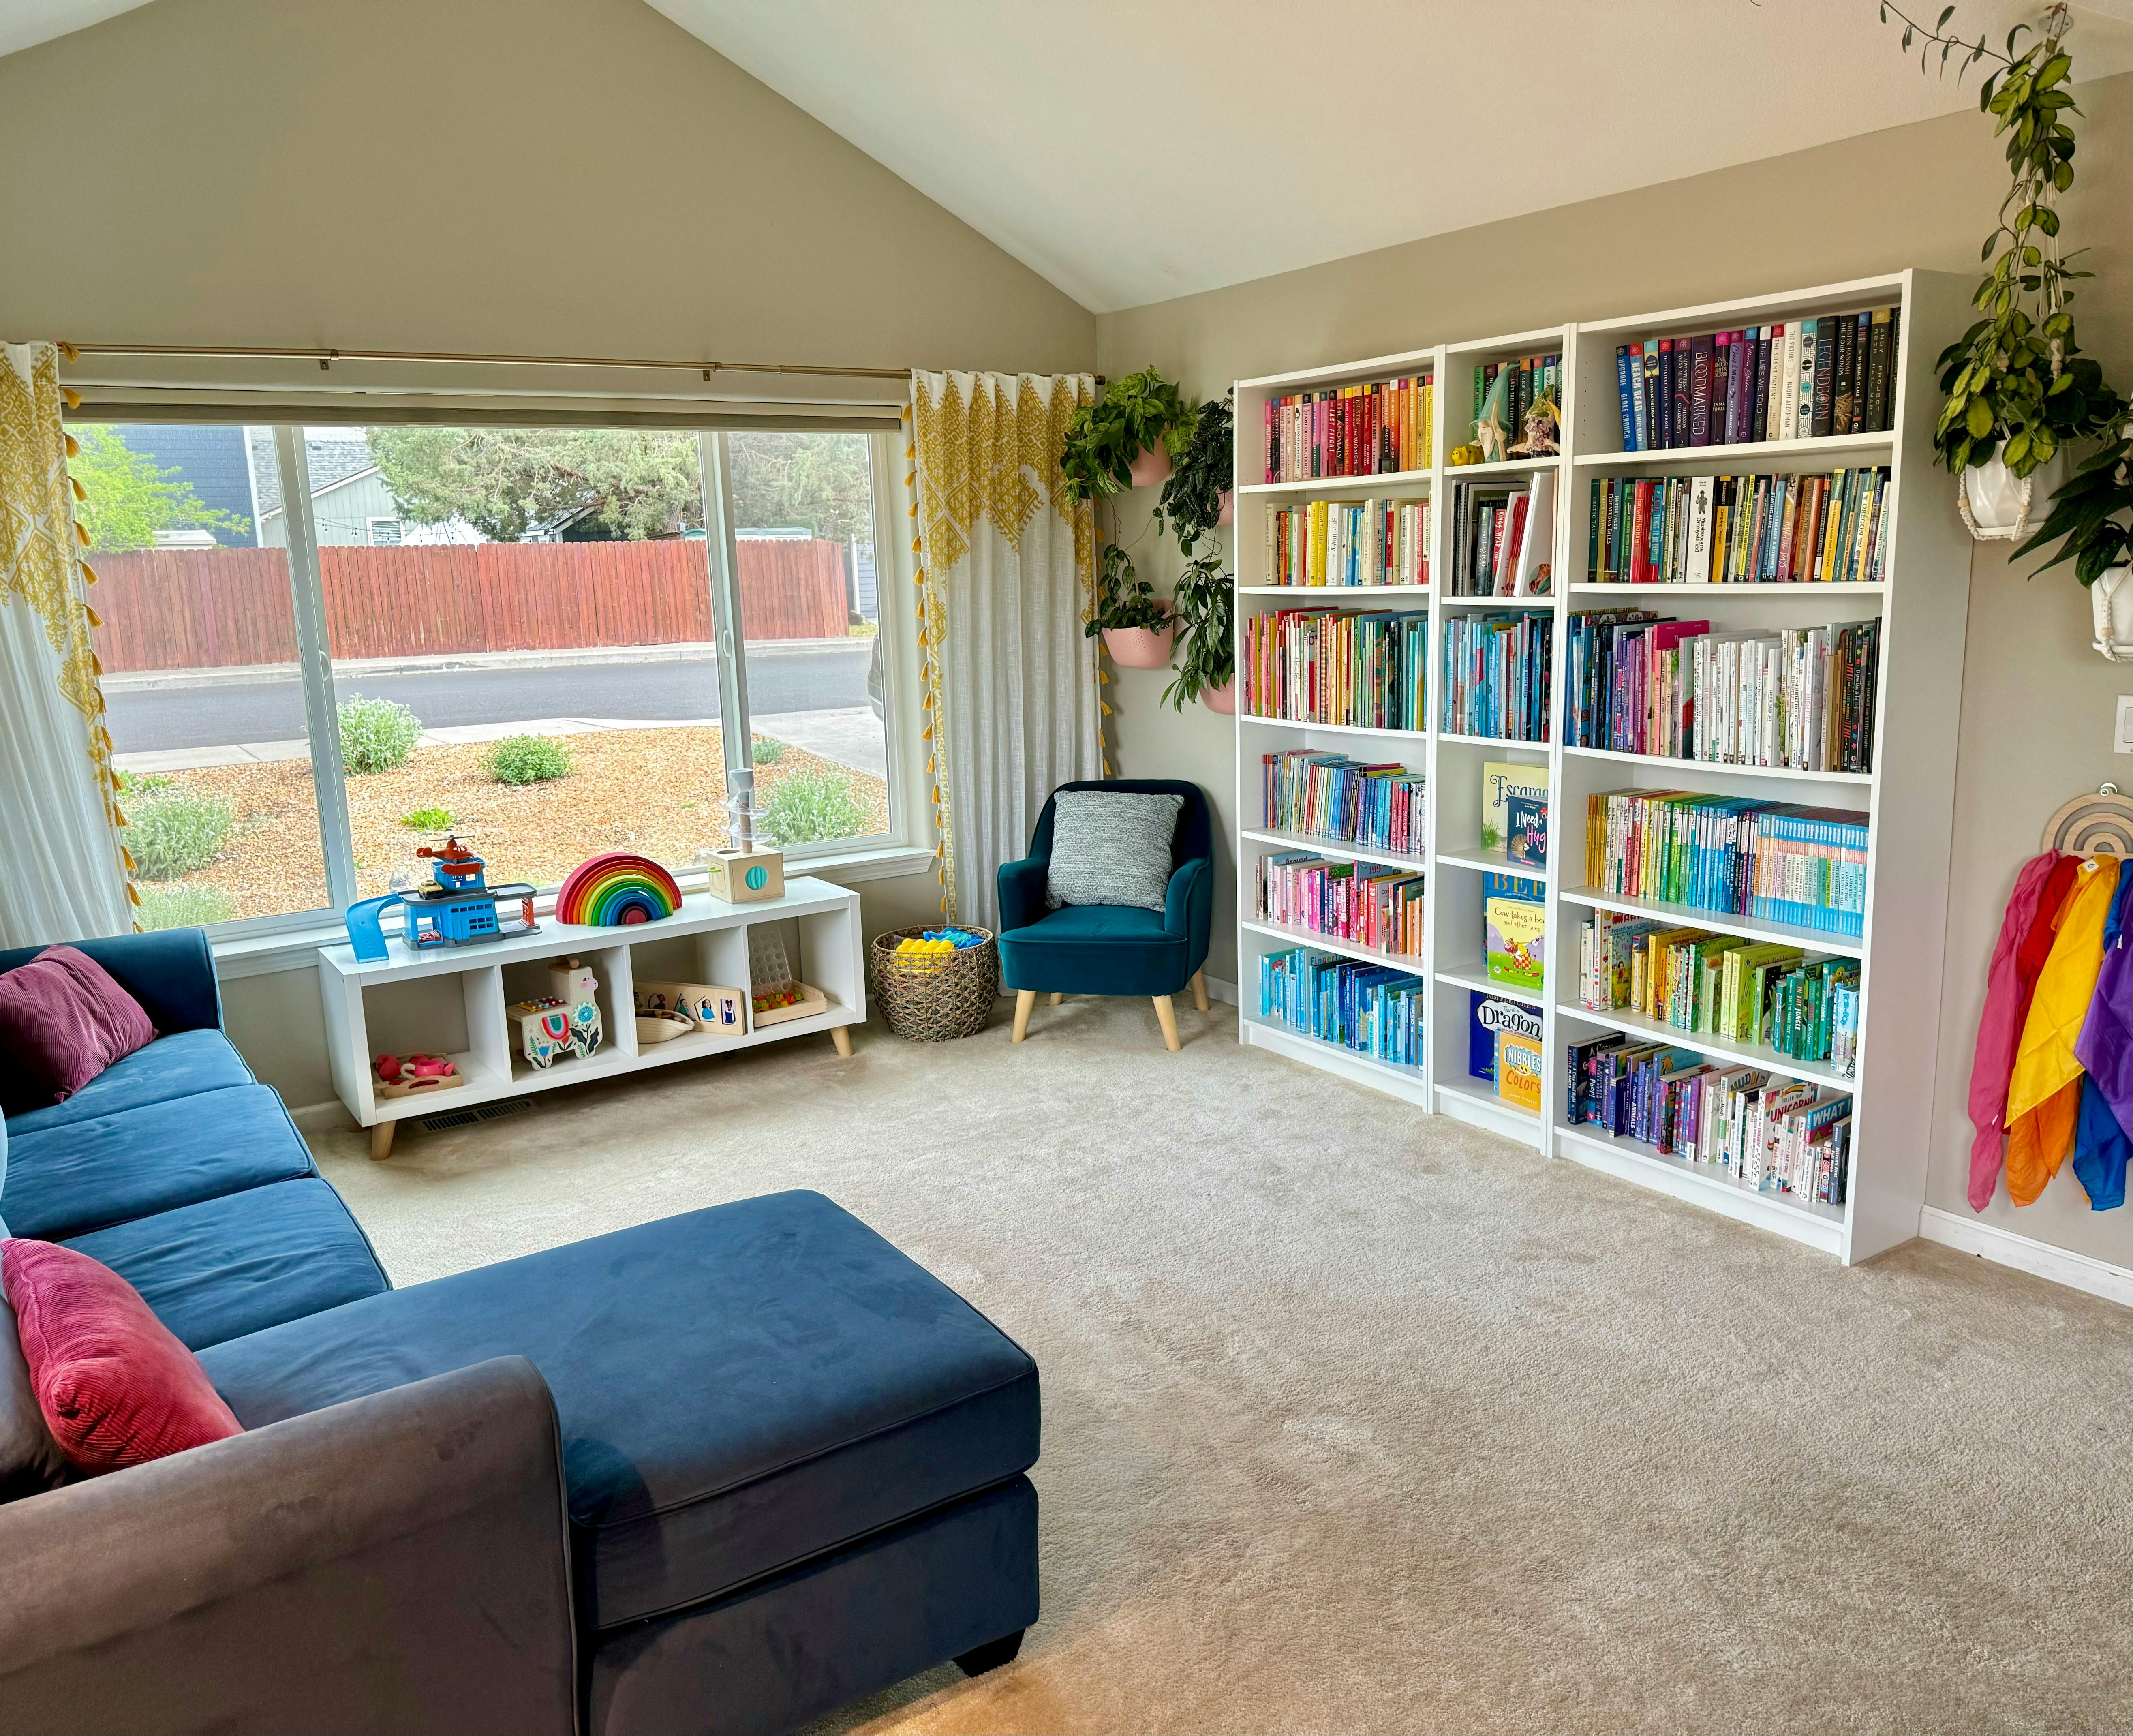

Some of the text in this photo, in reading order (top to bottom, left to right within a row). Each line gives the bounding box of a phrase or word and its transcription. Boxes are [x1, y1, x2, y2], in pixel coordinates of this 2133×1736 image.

[1618, 359, 1627, 386] UPGRADE
[1758, 378, 1764, 391] WE
[1816, 338, 1833, 420] LEGENDBORN
[1521, 391, 1525, 400] MY
[1632, 362, 1643, 411] BEACH READ
[1692, 351, 1708, 435] BLOODMARKED
[1621, 393, 1631, 439] BLAKE CROUCH
[1495, 511, 1505, 529] KINGS
[1859, 503, 1868, 535] OREGON
[1876, 510, 1888, 559] Pacific Northwest
[1515, 812, 1521, 827] I
[1521, 811, 1539, 828] Need
[1526, 825, 1546, 854] Hug
[1495, 907, 1509, 916] Cow
[1511, 910, 1528, 923] takes
[1529, 923, 1540, 933] tales
[1481, 1006, 1541, 1038] Dragon
[1508, 1048, 1541, 1072] NIBBLES
[1813, 1101, 1845, 1127] WHAT
